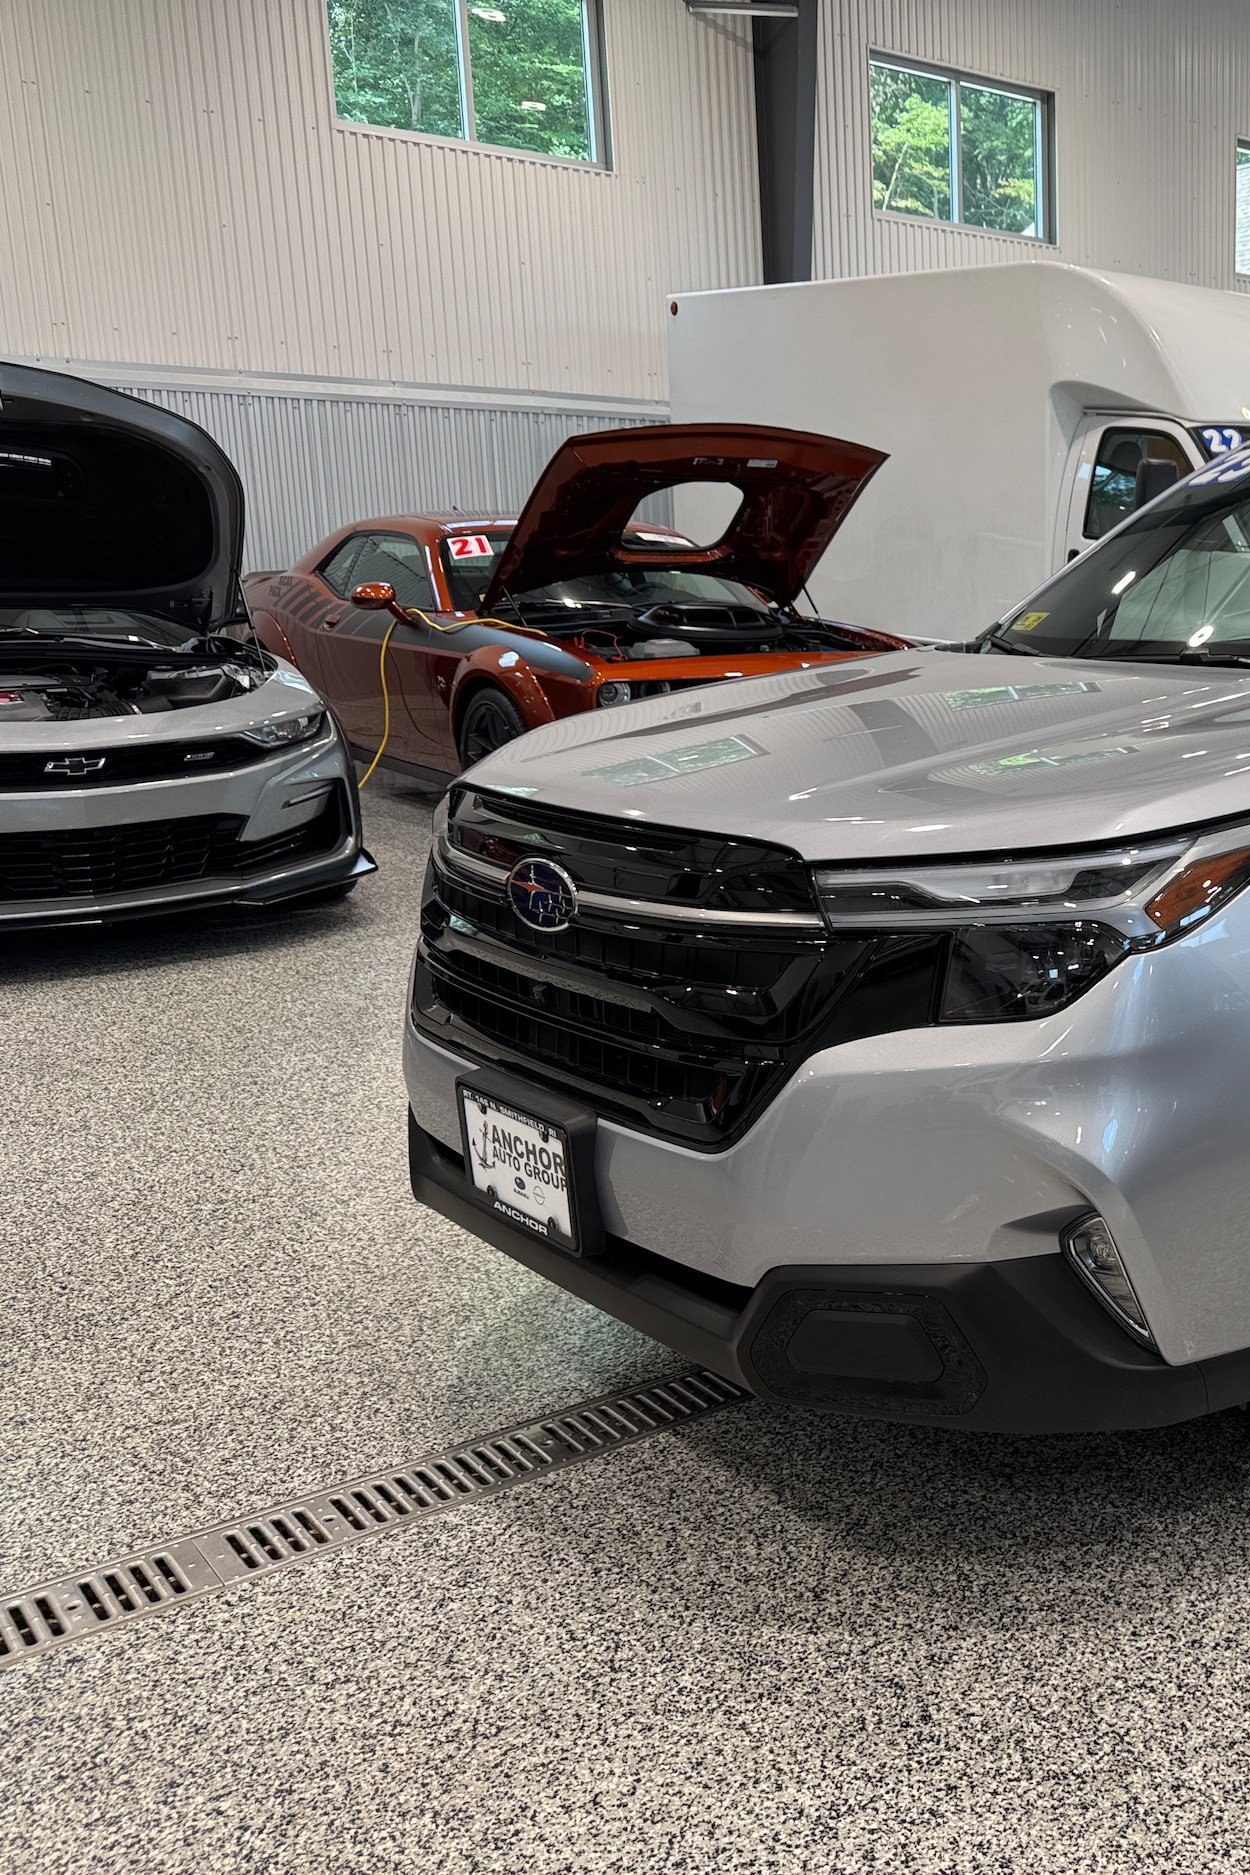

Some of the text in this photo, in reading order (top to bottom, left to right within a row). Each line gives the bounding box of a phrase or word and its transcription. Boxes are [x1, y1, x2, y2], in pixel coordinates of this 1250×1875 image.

[451, 537, 487, 556] 21
[475, 1095, 489, 1106] 146
[548, 1127, 557, 1137] RI
[492, 1124, 566, 1176] ANCHOR
[493, 1145, 568, 1192] AUTO GROUP
[493, 1201, 549, 1236] ANCHOR
